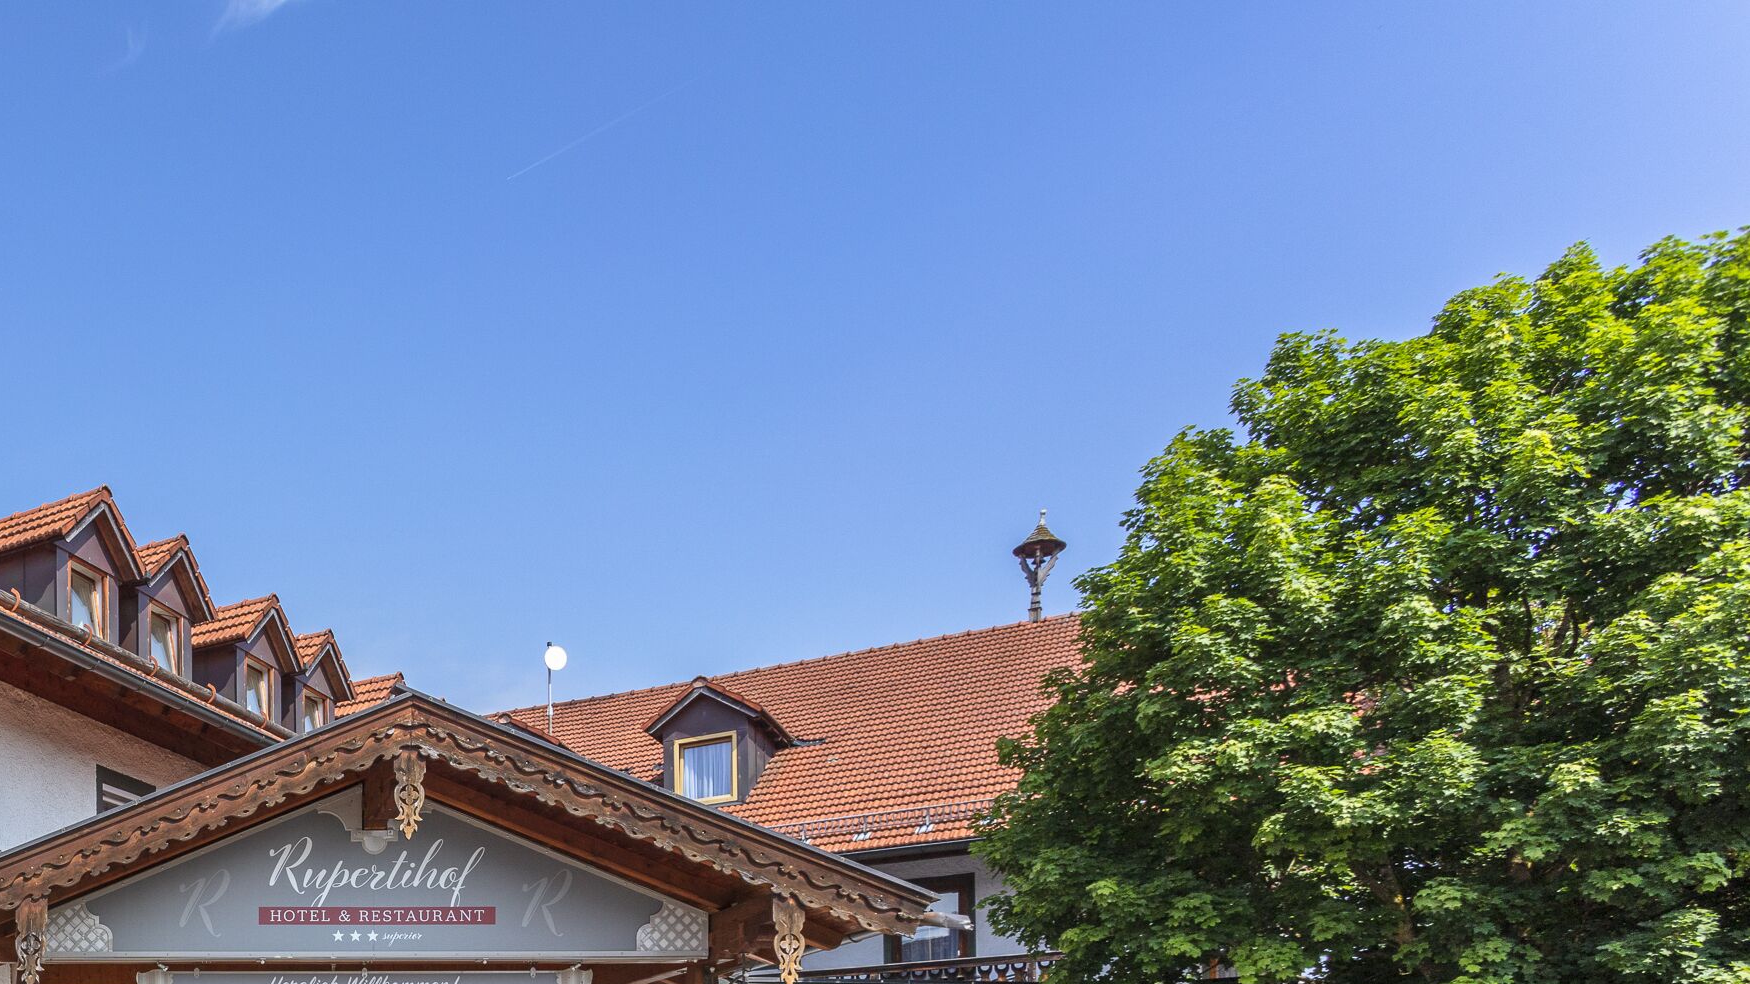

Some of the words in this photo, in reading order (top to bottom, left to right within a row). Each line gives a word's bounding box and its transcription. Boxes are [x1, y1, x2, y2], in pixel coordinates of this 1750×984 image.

[178, 868, 231, 938] R
[268, 836, 486, 907] Rupertihof
[521, 868, 573, 938] R
[270, 909, 331, 923] HOTEL
[338, 909, 351, 923] &
[358, 909, 486, 923] RESTAURANT
[382, 931, 423, 948] superior
